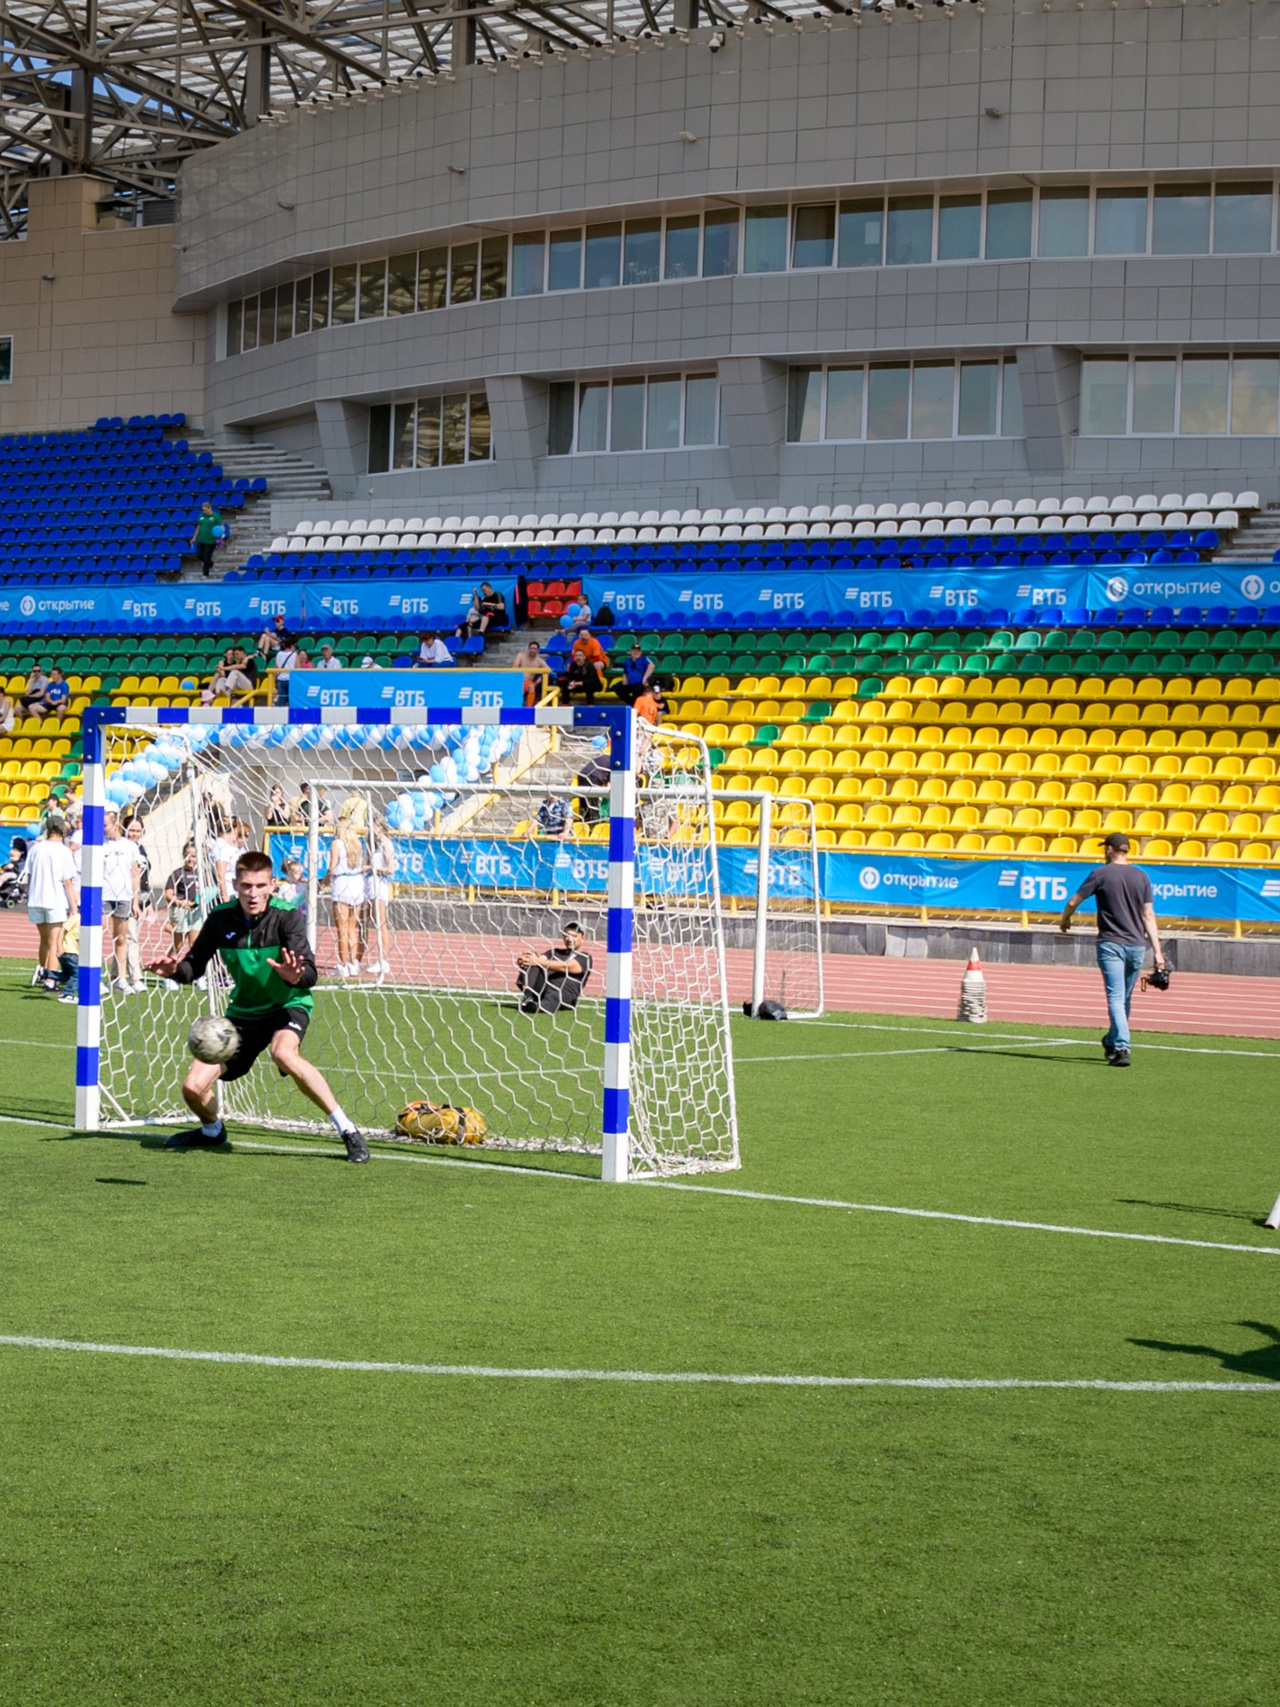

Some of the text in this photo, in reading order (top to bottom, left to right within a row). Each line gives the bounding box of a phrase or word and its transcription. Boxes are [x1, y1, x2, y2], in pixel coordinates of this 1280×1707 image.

[333, 598, 429, 614] ВТБ ВТБ
[616, 581, 1222, 610] ВТБ ВТБ ВТБ ВТБ ВТБ ВТБ открытие
[38, 599, 95, 613] открытие
[133, 602, 157, 617] ВТБ
[196, 601, 221, 616] ВТБ
[260, 600, 286, 615] ВТБ
[320, 689, 504, 708] ВТБ ВТБ ВТБ
[475, 855, 512, 875] ВТБ
[573, 859, 609, 879] ВТБ
[883, 873, 1218, 900] открытие ВТБ крытие
